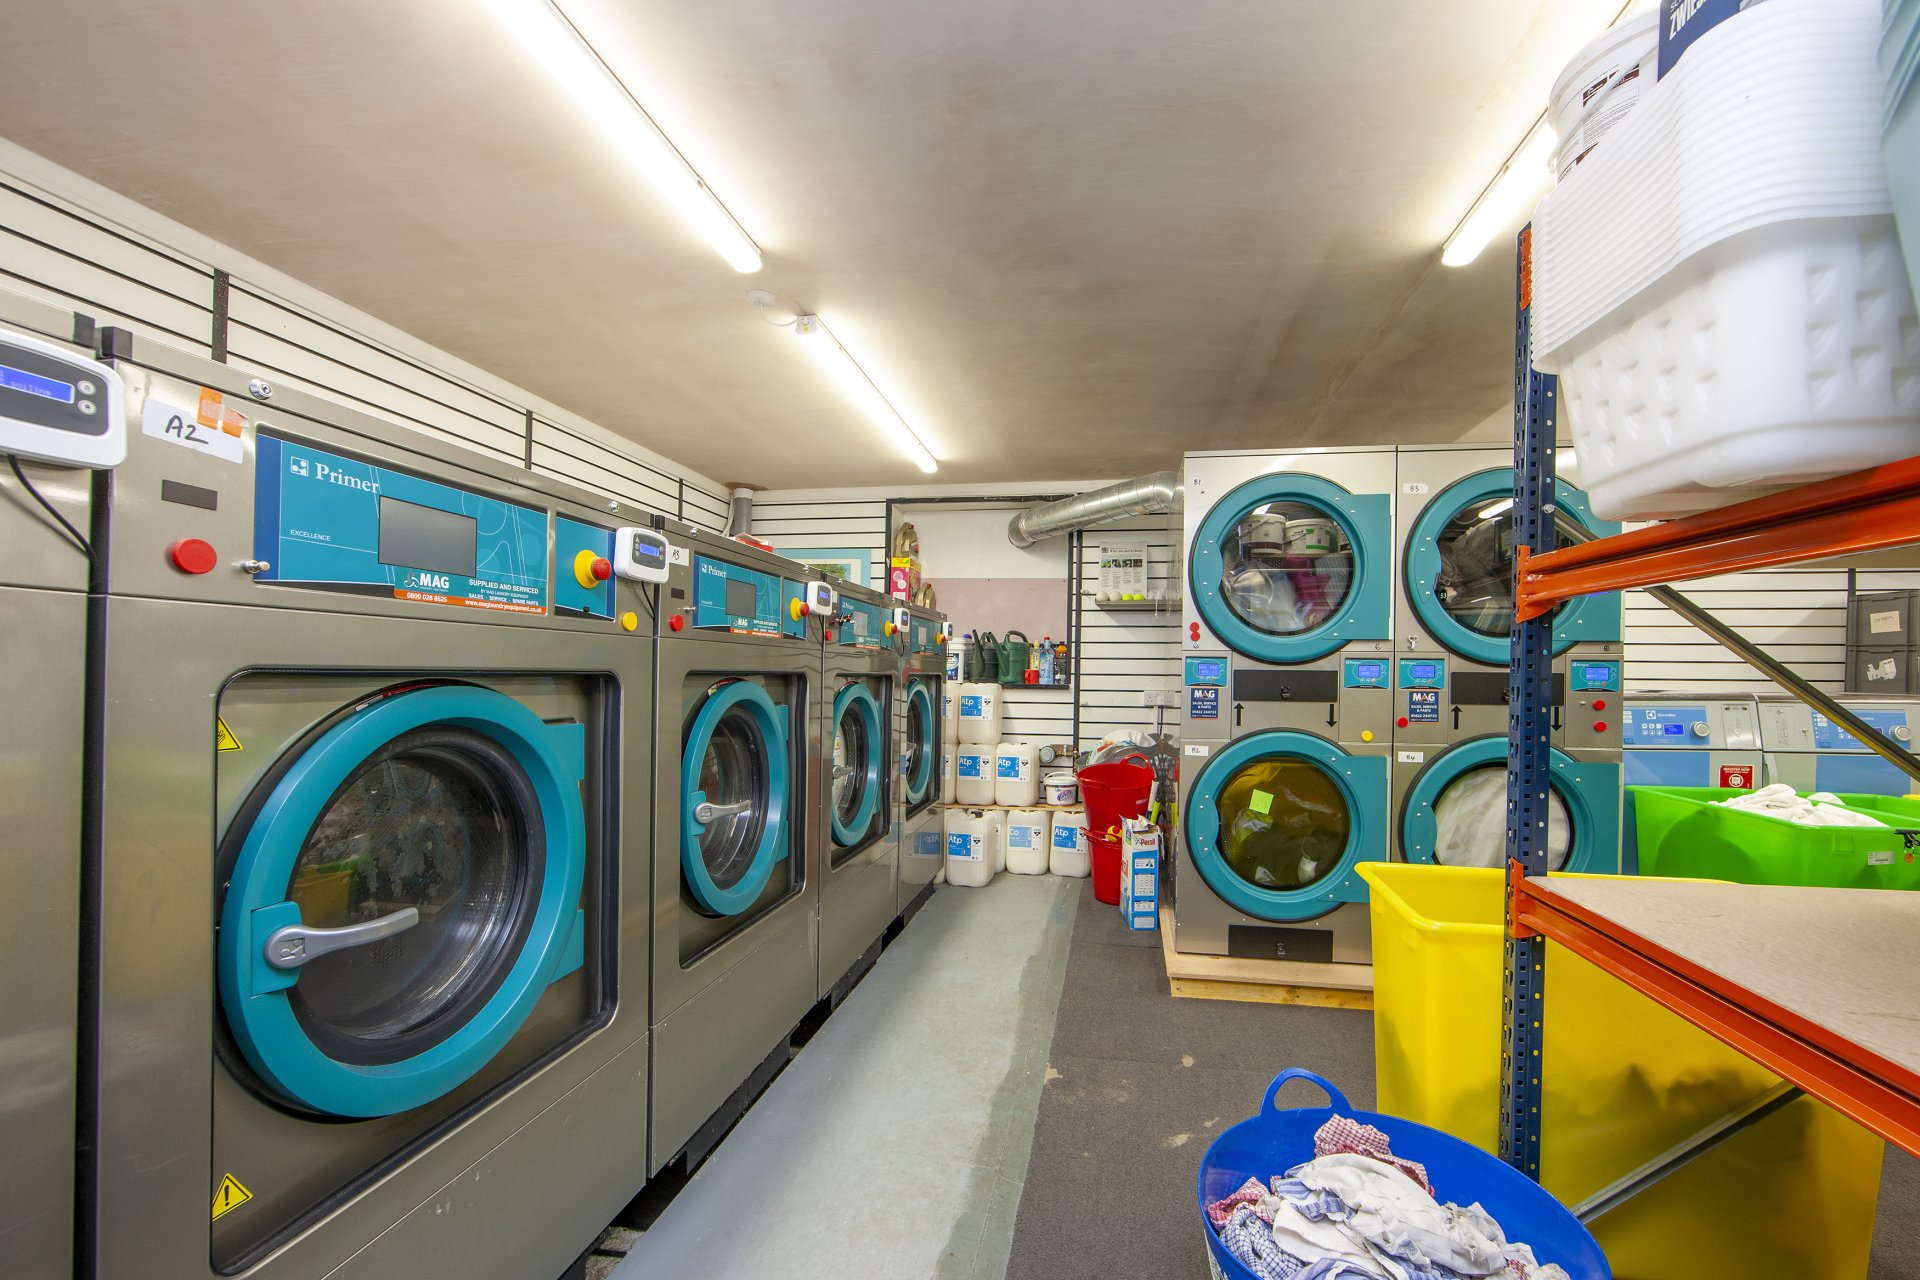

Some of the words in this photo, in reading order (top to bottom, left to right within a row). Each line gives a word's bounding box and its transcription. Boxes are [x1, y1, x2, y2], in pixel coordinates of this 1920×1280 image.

[165, 414, 209, 445] A2
[315, 462, 379, 493] Primer
[290, 529, 331, 541] EXCELLENCE
[708, 564, 727, 578] Primer
[420, 573, 449, 588] MAG
[468, 579, 499, 588] SUPPLIED
[512, 585, 539, 594] SERVICED
[406, 592, 421, 600] 0800
[1194, 690, 1215, 698] MAG
[1412, 693, 1435, 701] MAG
[960, 757, 972, 766] Atp
[998, 758, 1011, 767] Atp
[1055, 828, 1068, 837] Atp
[949, 835, 962, 845] Atp
